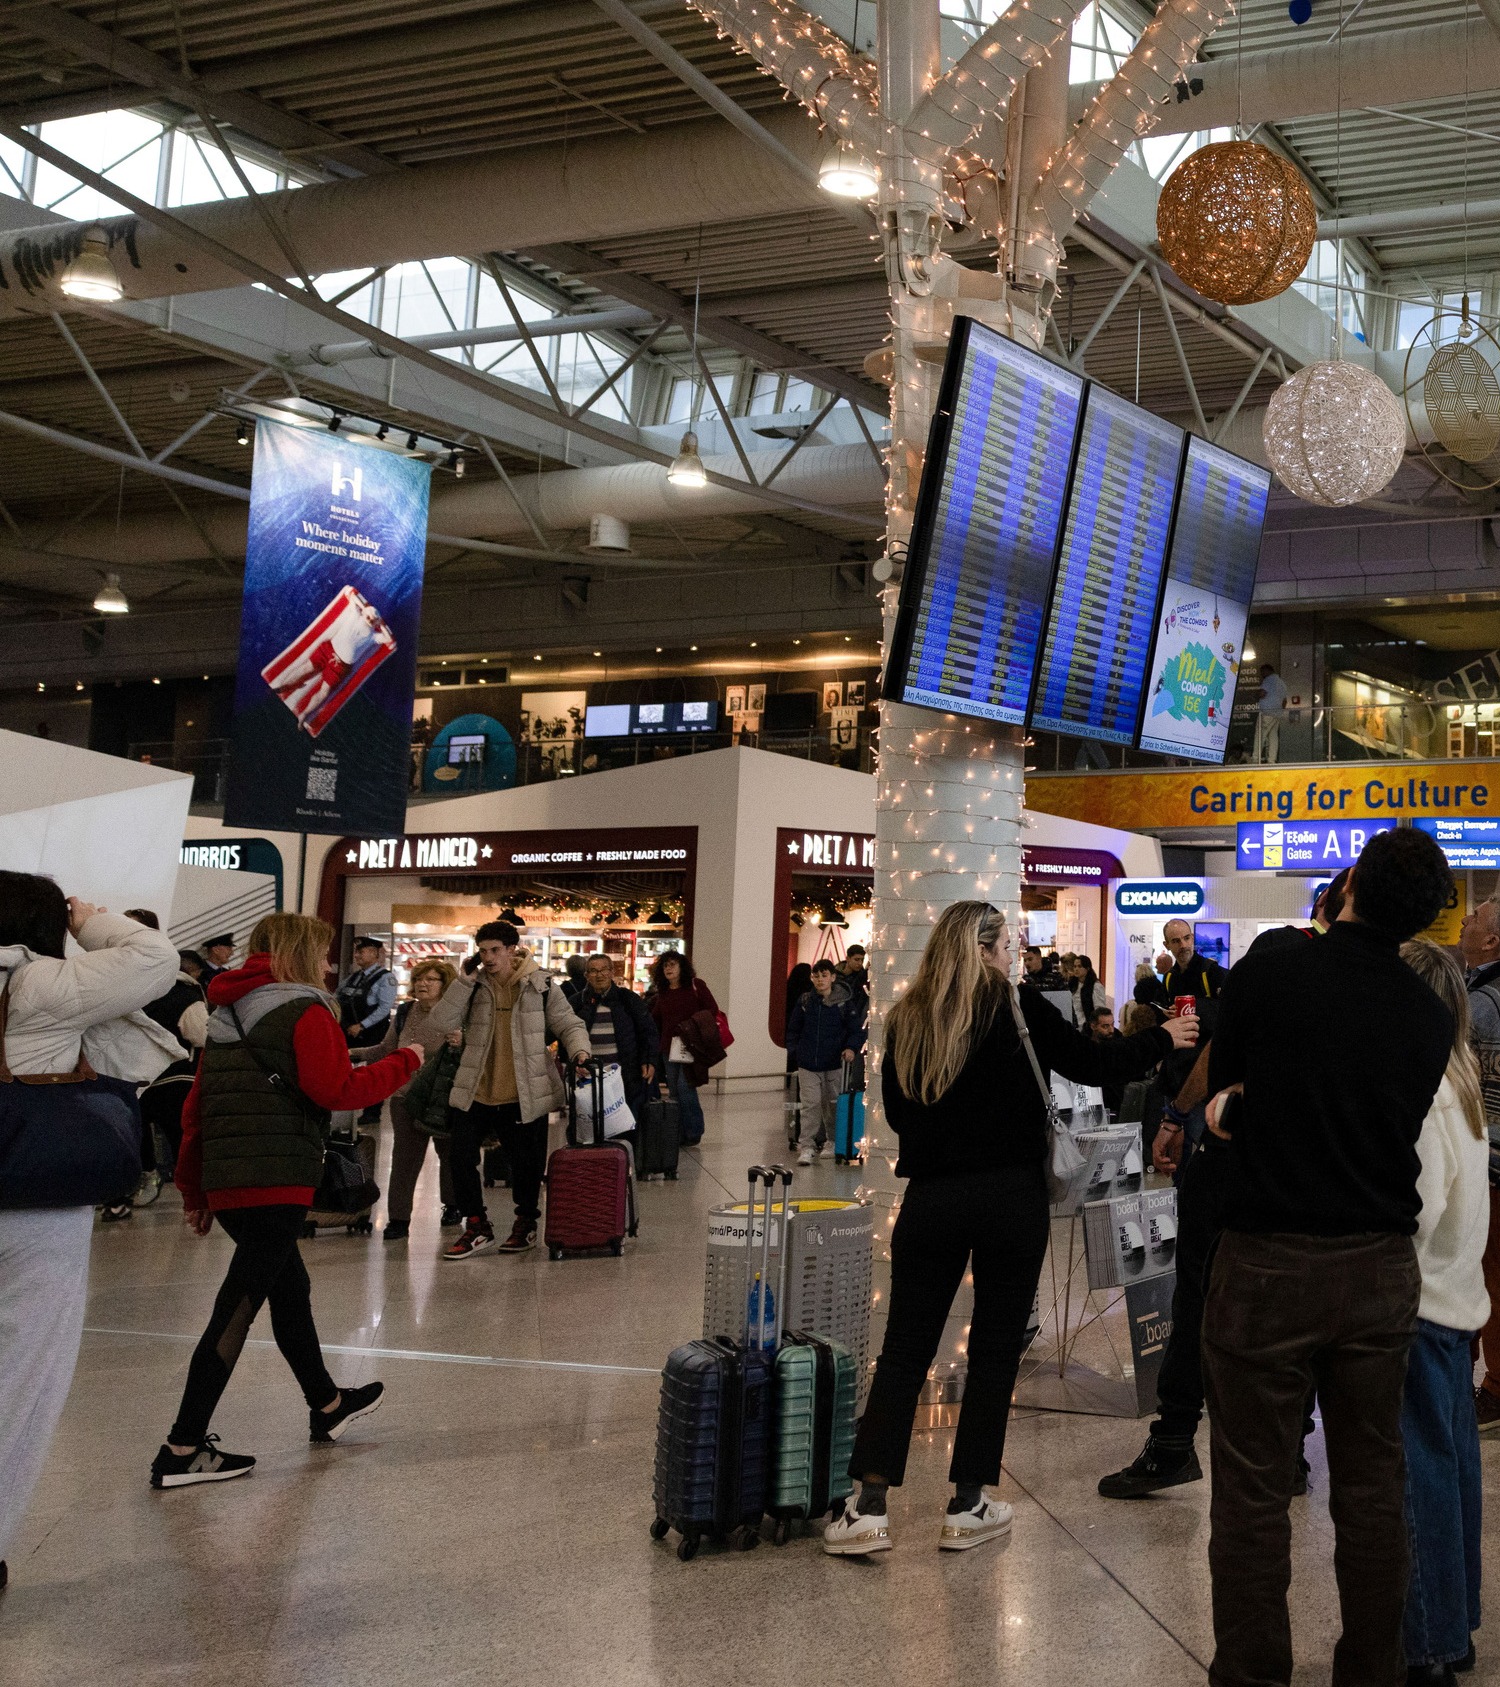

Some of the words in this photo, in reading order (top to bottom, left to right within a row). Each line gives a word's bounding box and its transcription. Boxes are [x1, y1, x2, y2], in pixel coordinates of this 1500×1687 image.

[330, 506, 360, 518] HOTELS
[302, 520, 340, 541] Where
[342, 530, 380, 553] holiday
[296, 538, 347, 556] moments
[350, 550, 384, 565] matter
[1176, 602, 1200, 614] DISCOVER
[1180, 616, 1188, 624] THE
[1189, 618, 1208, 627] COMBOS
[1178, 649, 1218, 685] Meal
[1181, 680, 1208, 697] COMBO
[1184, 696, 1201, 714] 15€
[1144, 740, 1154, 749] prior
[1159, 742, 1181, 753] Scheduled
[1180, 746, 1190, 754] Time
[1190, 784, 1293, 819] Caring
[1306, 780, 1352, 809] for
[1365, 780, 1488, 808] Culture
[1284, 830, 1318, 846] Έξοδοι
[1436, 832, 1462, 840] Check-in
[803, 834, 842, 866] PRET
[846, 836, 856, 866] A
[1323, 830, 1342, 858] A
[1350, 830, 1366, 858] B
[359, 839, 398, 868] PRET
[400, 840, 412, 868] A
[416, 838, 478, 868] MANGER
[511, 854, 550, 864] ORGANIC
[551, 852, 582, 862] COFFEE
[596, 851, 633, 861] FRESHLY
[634, 850, 659, 860] MADE
[660, 850, 686, 860] FOOD
[1286, 848, 1312, 860] Gates
[1461, 858, 1496, 866] Information
[1036, 864, 1062, 874] FRESHLY
[1064, 866, 1082, 875] MADE
[1082, 867, 1102, 876] FOOD
[1120, 891, 1198, 906] EXCHANGE
[522, 913, 549, 924] Proudly
[551, 914, 578, 924] serving
[1150, 1226, 1160, 1235] NEXT
[1120, 1234, 1130, 1243] NEXT
